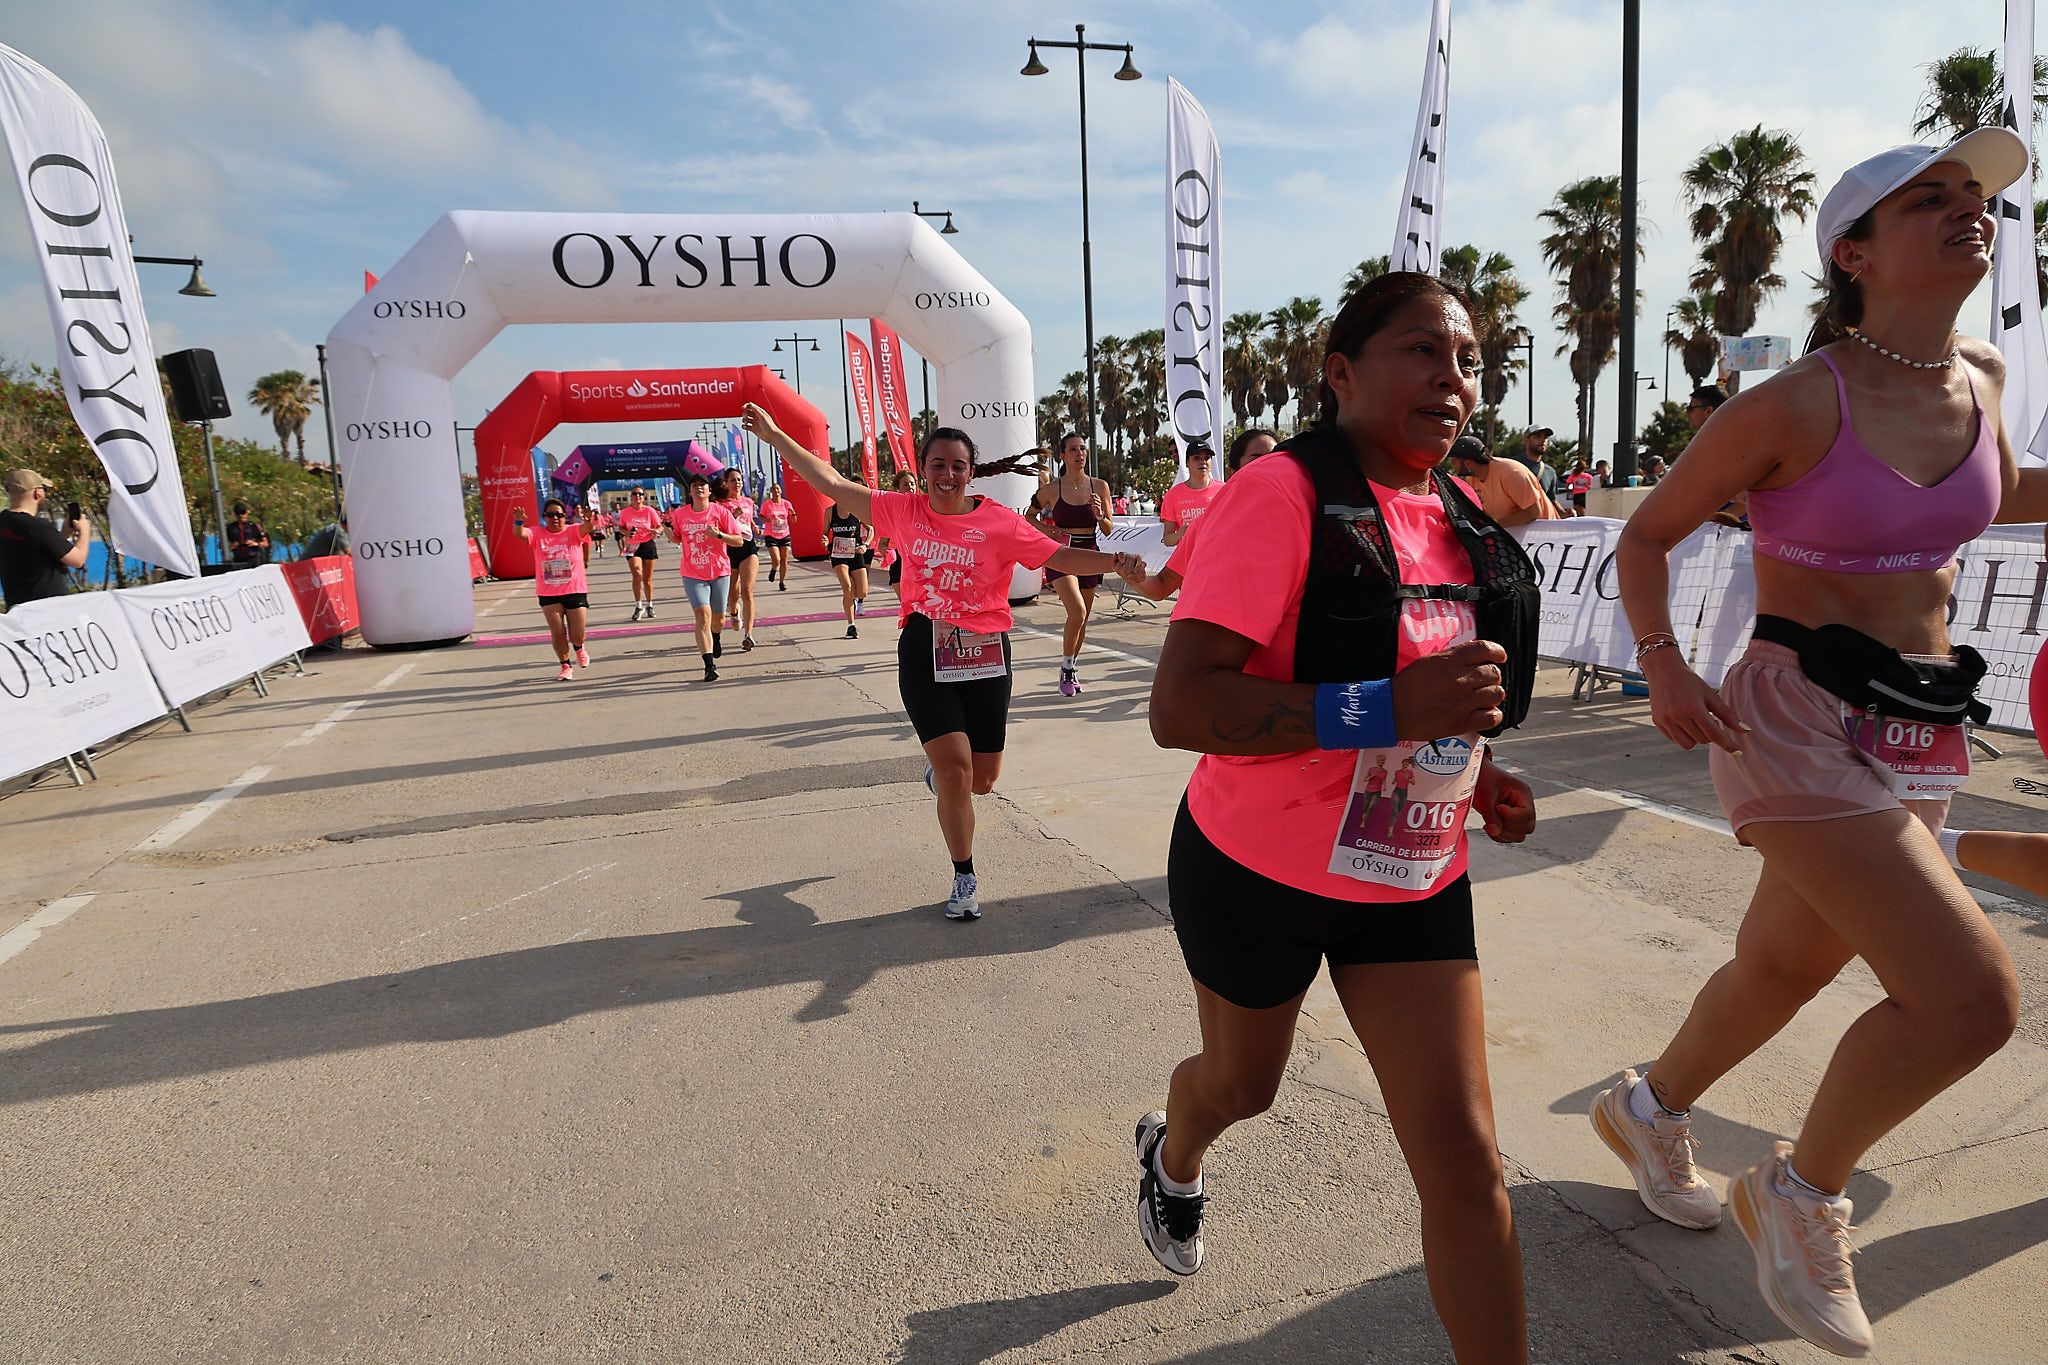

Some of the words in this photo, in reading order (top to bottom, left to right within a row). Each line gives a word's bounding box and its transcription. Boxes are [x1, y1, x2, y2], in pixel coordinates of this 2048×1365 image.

[552, 232, 837, 289] OYSHO
[373, 299, 466, 319] OYSHO
[915, 291, 990, 310] OYSHO
[570, 383, 624, 402] Sports
[650, 379, 735, 397] Santander
[960, 401, 1029, 420] OYSHO
[346, 420, 432, 443] OYSHO
[359, 536, 444, 559] OYSHO
[1778, 544, 1826, 566] NIKE
[1529, 542, 1620, 600] SHO
[1876, 552, 1921, 569] NIKE
[938, 568, 962, 592] DE
[151, 595, 232, 650] OYSHO
[957, 646, 982, 658] 016
[1886, 722, 1936, 748] 016
[1897, 751, 1921, 762] 2047
[1924, 765, 1958, 773] VALENCIA
[1916, 782, 1959, 792] Santander
[1406, 802, 1457, 830] 016
[1355, 838, 1396, 855] CARRERA
[1398, 847, 1411, 858] DE
[1411, 850, 1420, 858] LA
[1416, 834, 1441, 847] 3273
[1352, 857, 1409, 879] OYSHO
